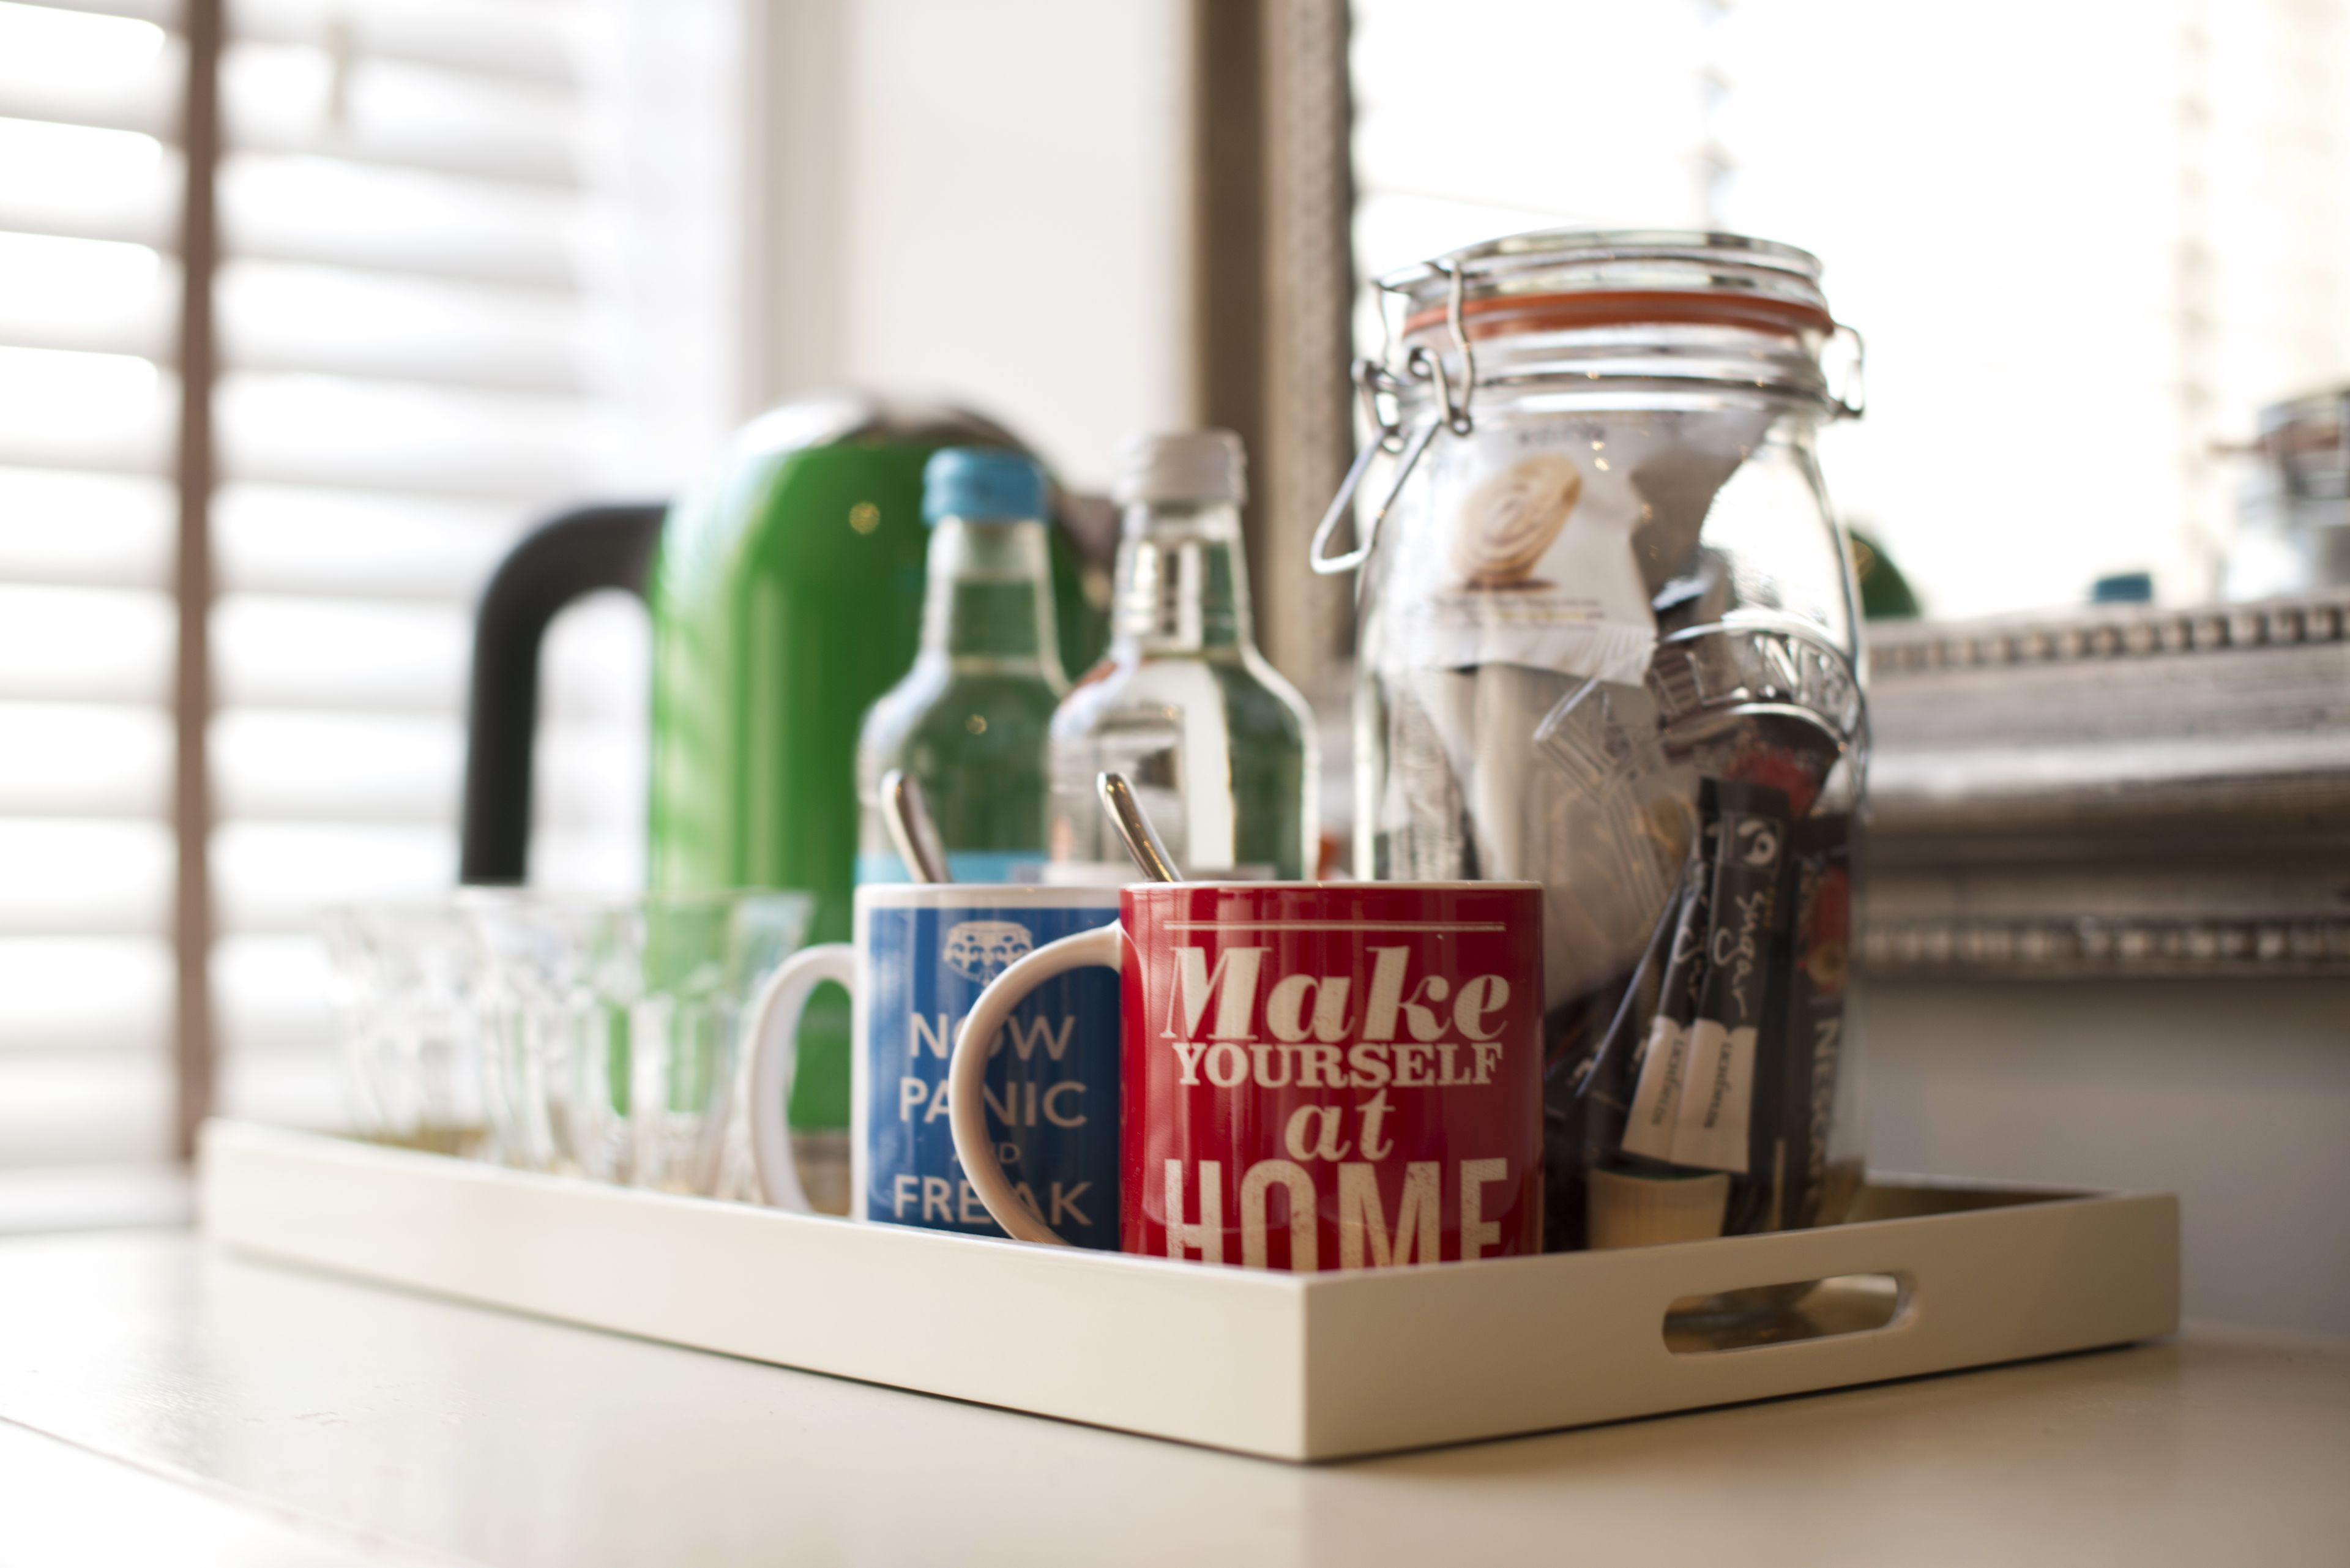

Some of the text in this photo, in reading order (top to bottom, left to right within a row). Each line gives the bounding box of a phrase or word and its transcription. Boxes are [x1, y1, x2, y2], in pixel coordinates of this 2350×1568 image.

[1159, 946, 1510, 1042] Make
[1172, 1042, 1503, 1089] YOURSELF
[1285, 1089, 1396, 1162] at
